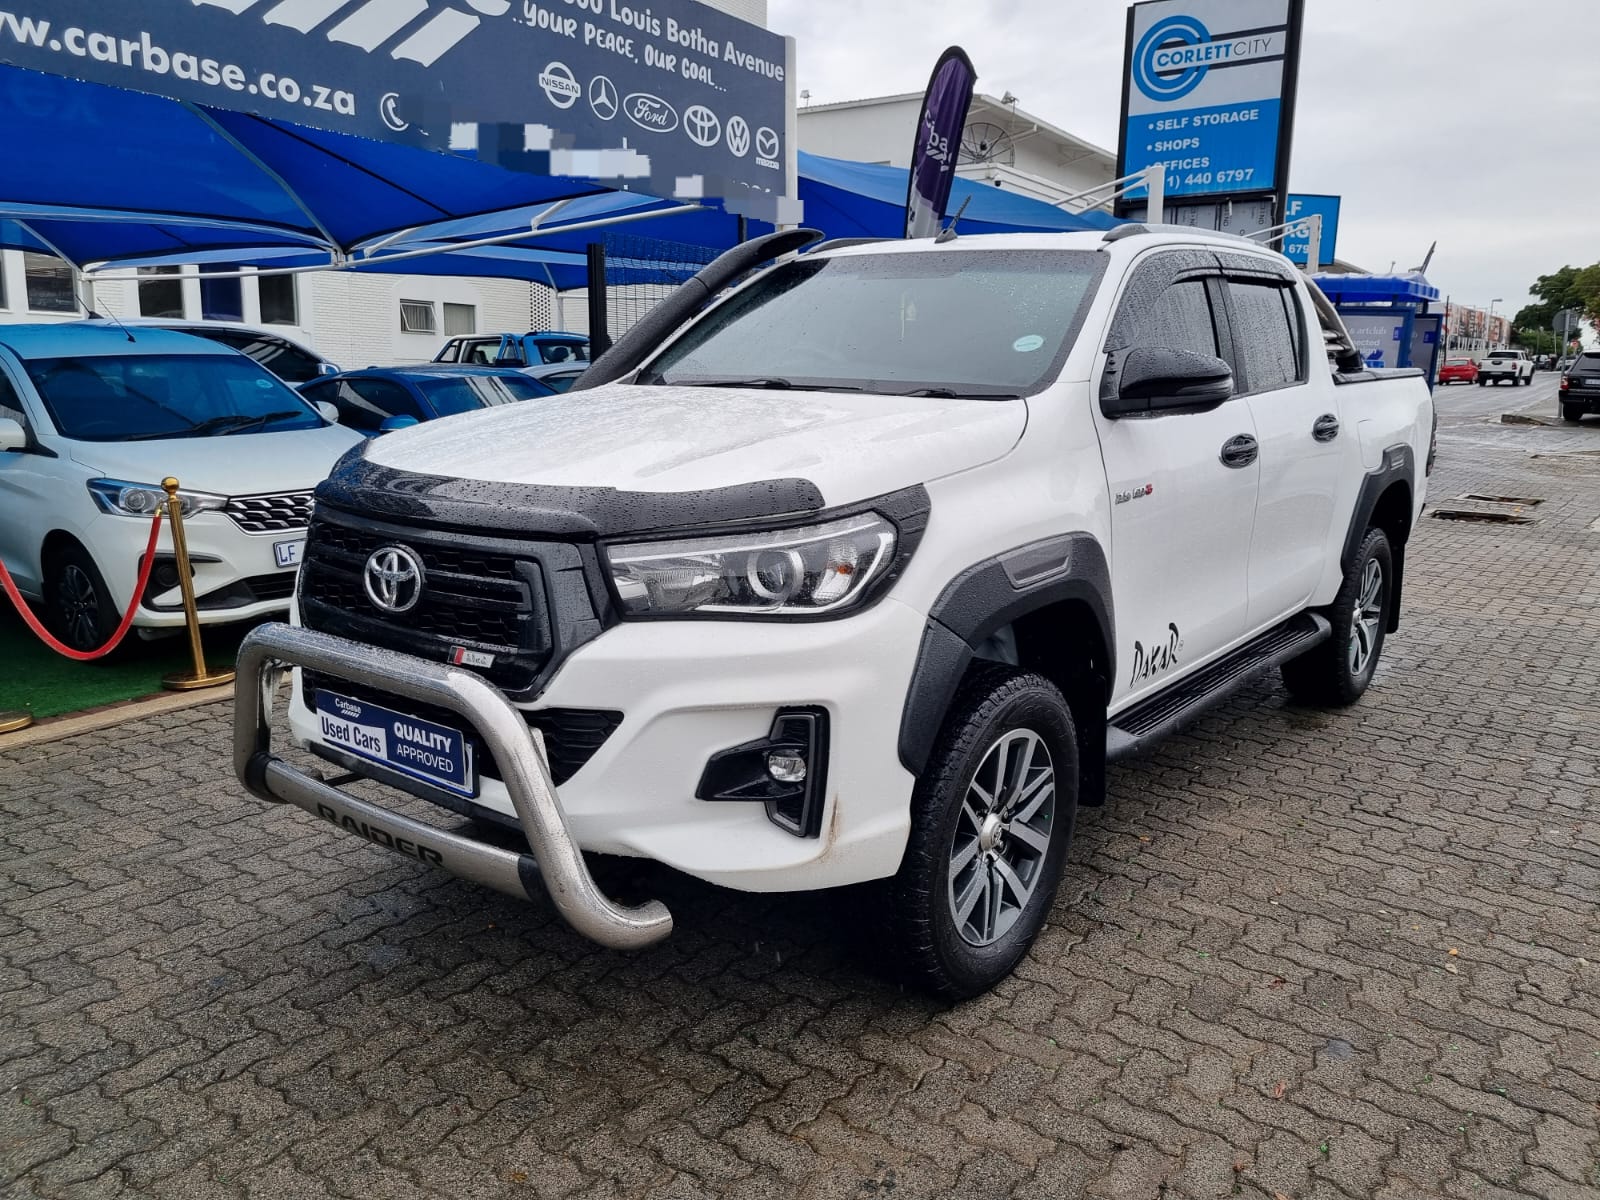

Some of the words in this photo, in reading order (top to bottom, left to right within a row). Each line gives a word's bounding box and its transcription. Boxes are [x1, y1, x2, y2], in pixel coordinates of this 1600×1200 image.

[584, 22, 639, 64] PEACE,
[644, 44, 676, 73] OUR
[610, 0, 661, 36] Louis
[667, 18, 719, 58] Botha
[724, 41, 785, 82] Avenue
[0, 11, 355, 115] w.carbase.co.za
[541, 77, 579, 94] NISSAN
[633, 97, 668, 127] Ford
[1156, 118, 1189, 131] SELF
[1193, 109, 1259, 126] STORAGE
[1154, 137, 1200, 152] SHOPS
[1184, 172, 1212, 186] 440
[1216, 168, 1254, 183] 6797
[335, 697, 362, 714] Carbase
[321, 716, 350, 742] Used
[353, 726, 381, 753] Cars
[394, 721, 452, 753] QUALITY
[396, 744, 454, 774] APPROVED
[317, 802, 445, 868] RAIDER
